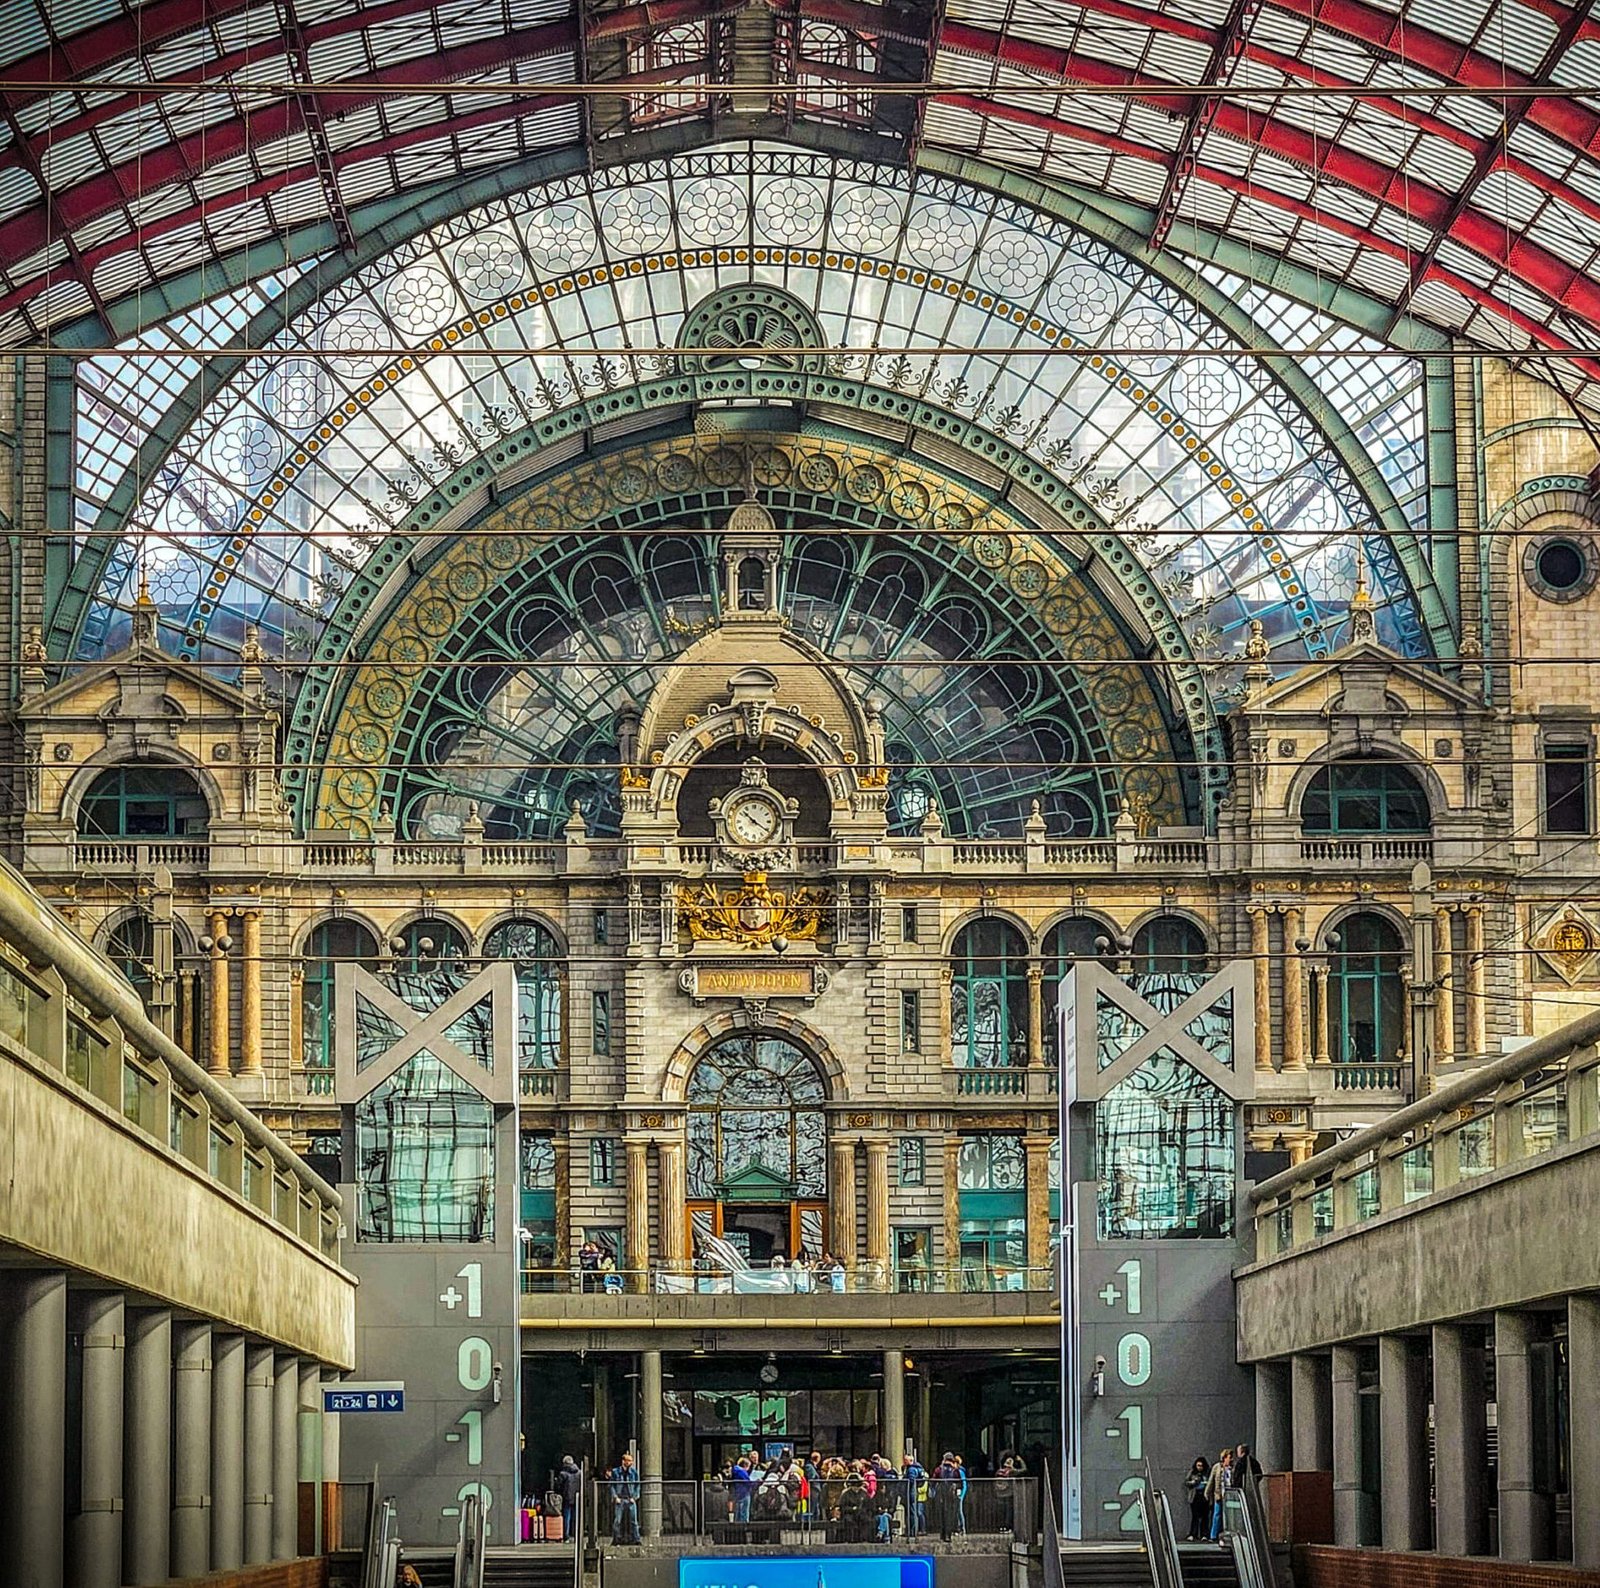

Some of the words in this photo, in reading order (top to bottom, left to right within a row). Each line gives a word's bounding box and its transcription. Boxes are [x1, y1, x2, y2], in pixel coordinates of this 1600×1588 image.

[707, 973, 802, 988] ANTWERPEN
[439, 1262, 483, 1318] +1
[1098, 1258, 1142, 1315] +1
[458, 1336, 492, 1391] 0
[1117, 1332, 1152, 1387] 0
